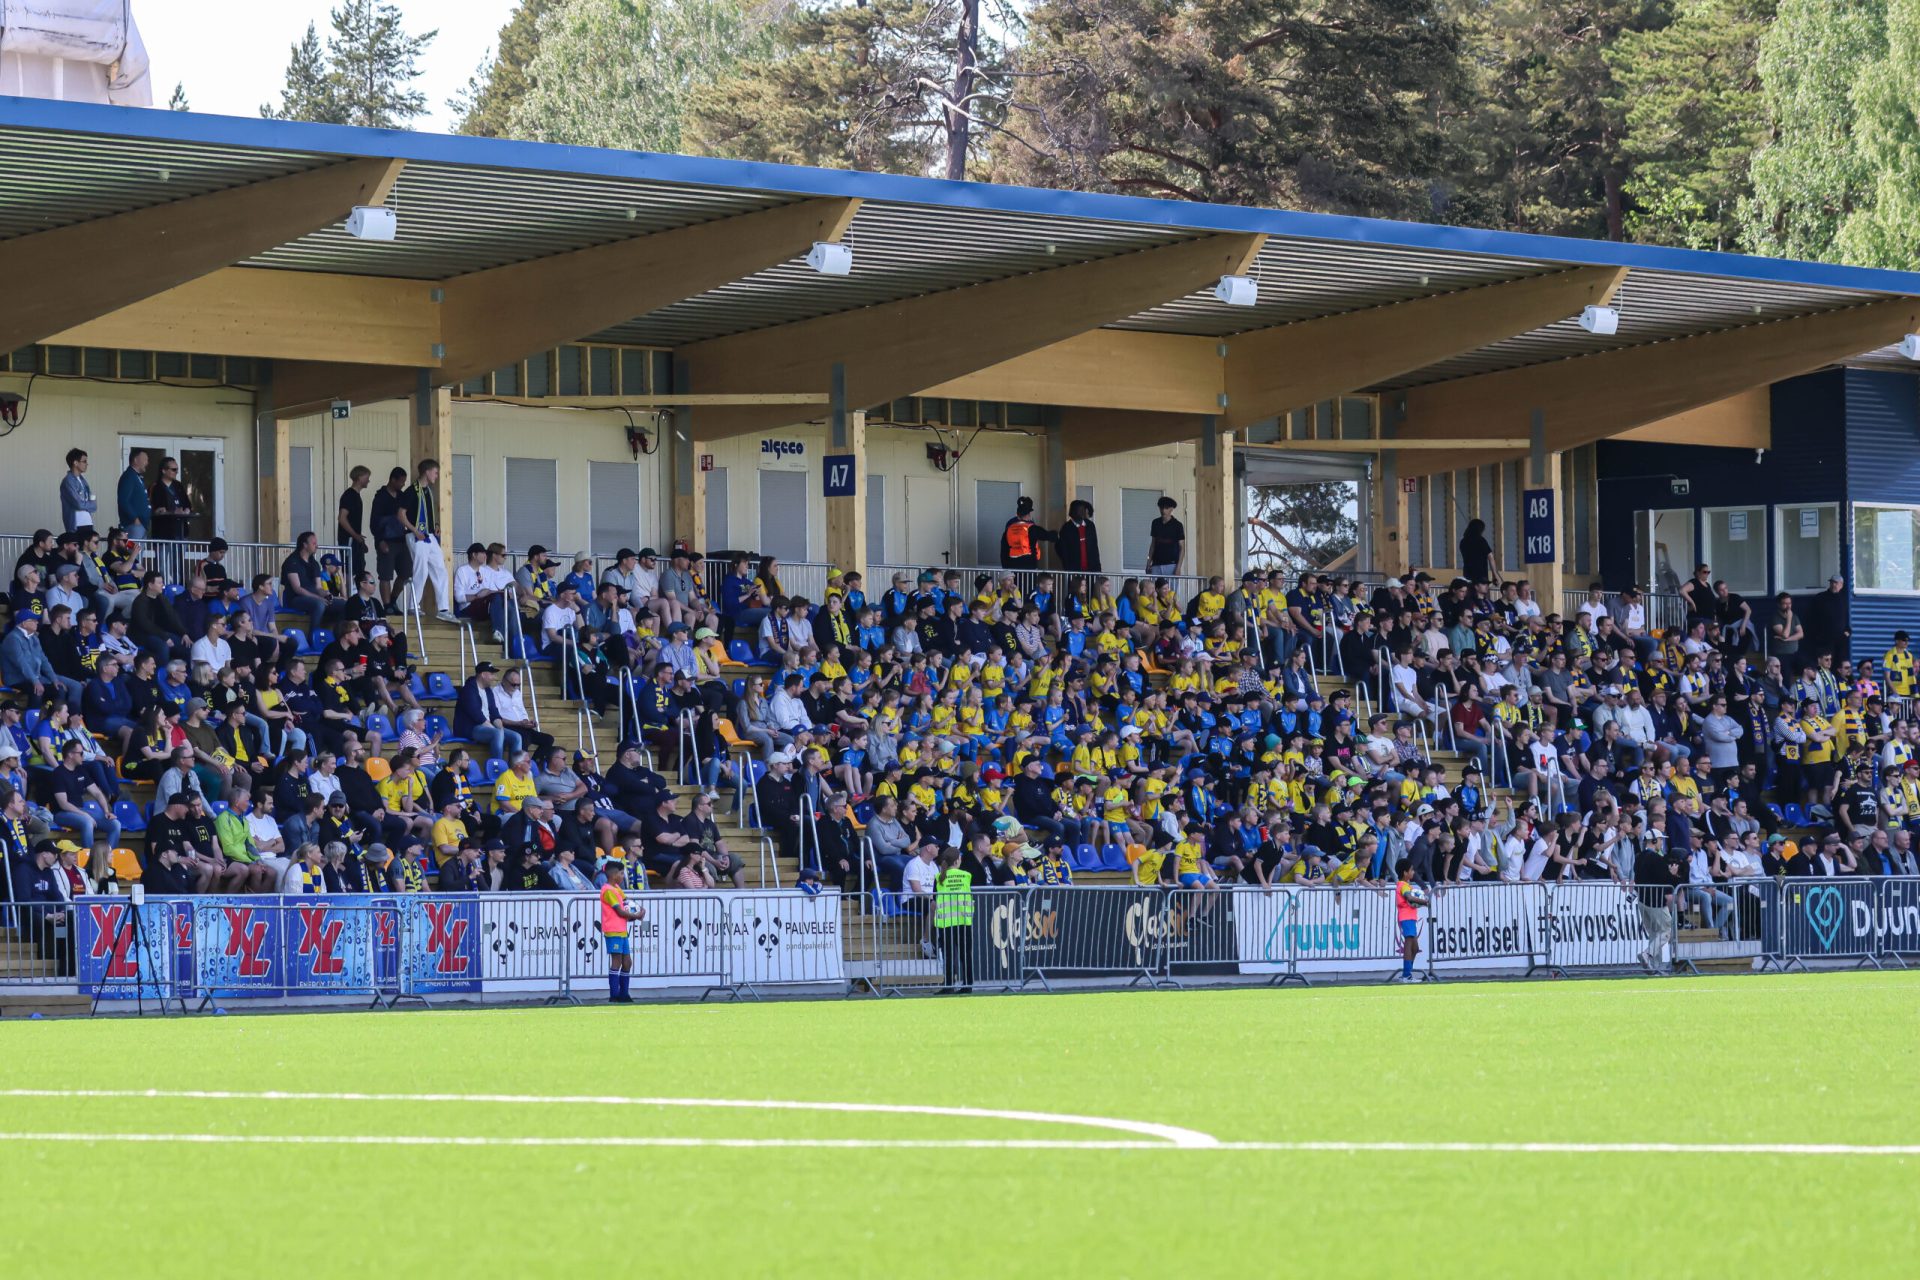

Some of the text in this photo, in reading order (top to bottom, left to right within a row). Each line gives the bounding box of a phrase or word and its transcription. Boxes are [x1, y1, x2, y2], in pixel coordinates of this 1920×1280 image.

[761, 439, 804, 460] algeco
[830, 464, 849, 487] A7
[1529, 497, 1548, 518] A8
[1528, 535, 1551, 555] K18
[374, 911, 395, 946] XL
[522, 926, 568, 940] TURVAA
[706, 922, 750, 936] TURVAA
[785, 921, 836, 935] PALVELEE
[991, 899, 1058, 968] Classic
[1284, 917, 1360, 951] ruutu
[1427, 916, 1520, 954] Tasolaiset
[1852, 900, 1920, 937] Duun
[89, 904, 139, 979] XL
[221, 904, 271, 977] XL
[296, 902, 345, 975] XL
[422, 902, 470, 975] XL
[121, 984, 142, 993] DRIN
